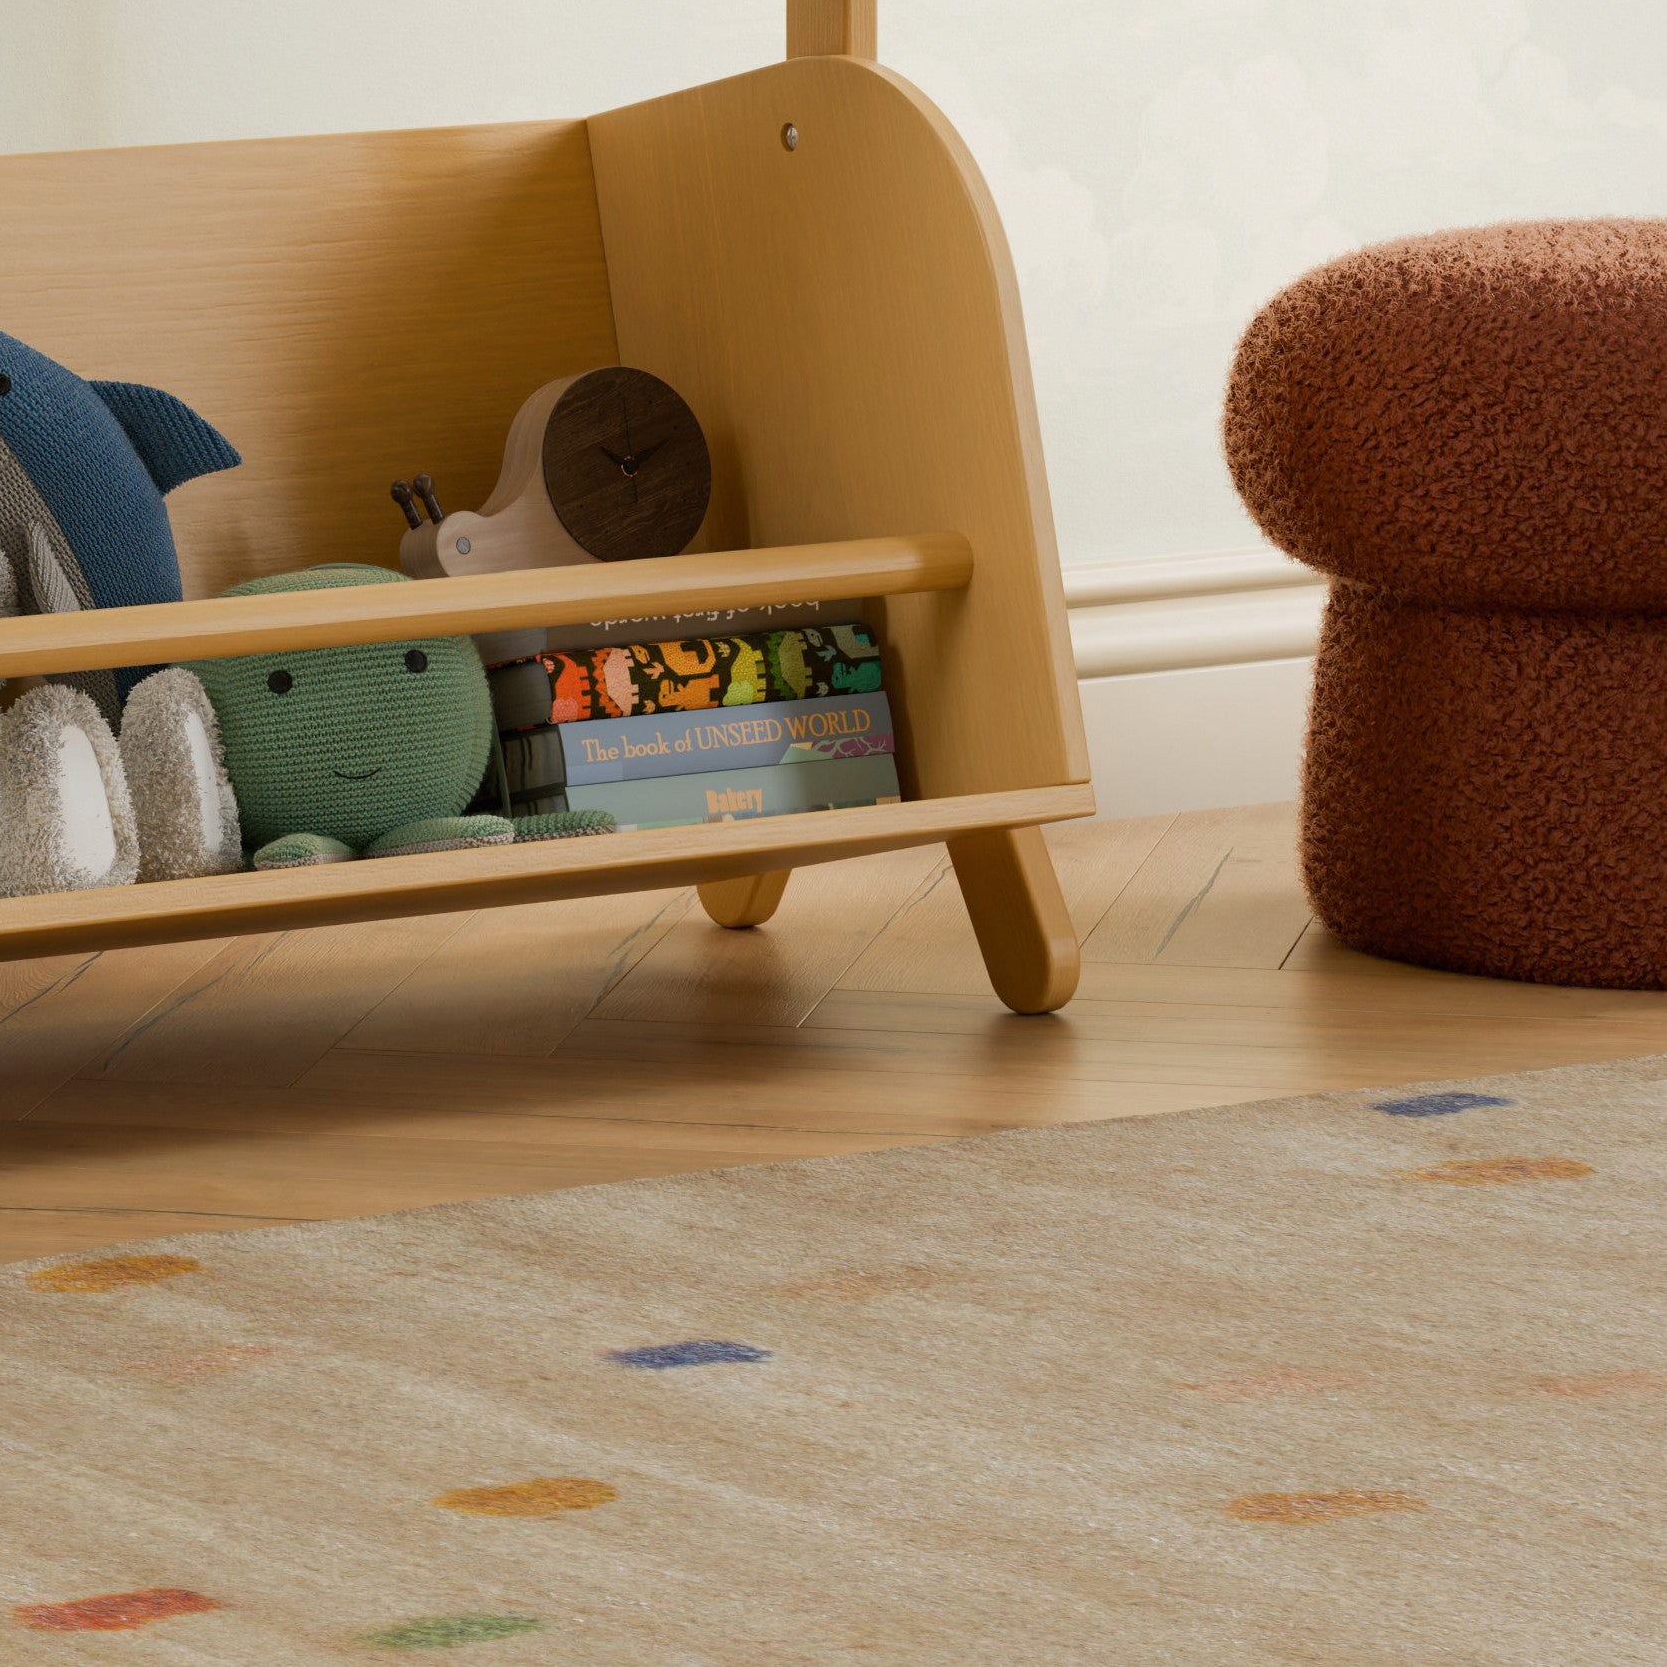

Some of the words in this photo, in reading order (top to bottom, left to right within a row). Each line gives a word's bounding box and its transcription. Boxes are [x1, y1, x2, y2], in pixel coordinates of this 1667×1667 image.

[581, 739, 619, 763] The
[623, 732, 671, 759] book
[674, 730, 695, 751] of
[693, 718, 782, 750] UNSEED
[784, 709, 872, 739] WORLD
[705, 787, 763, 814] Bakery
